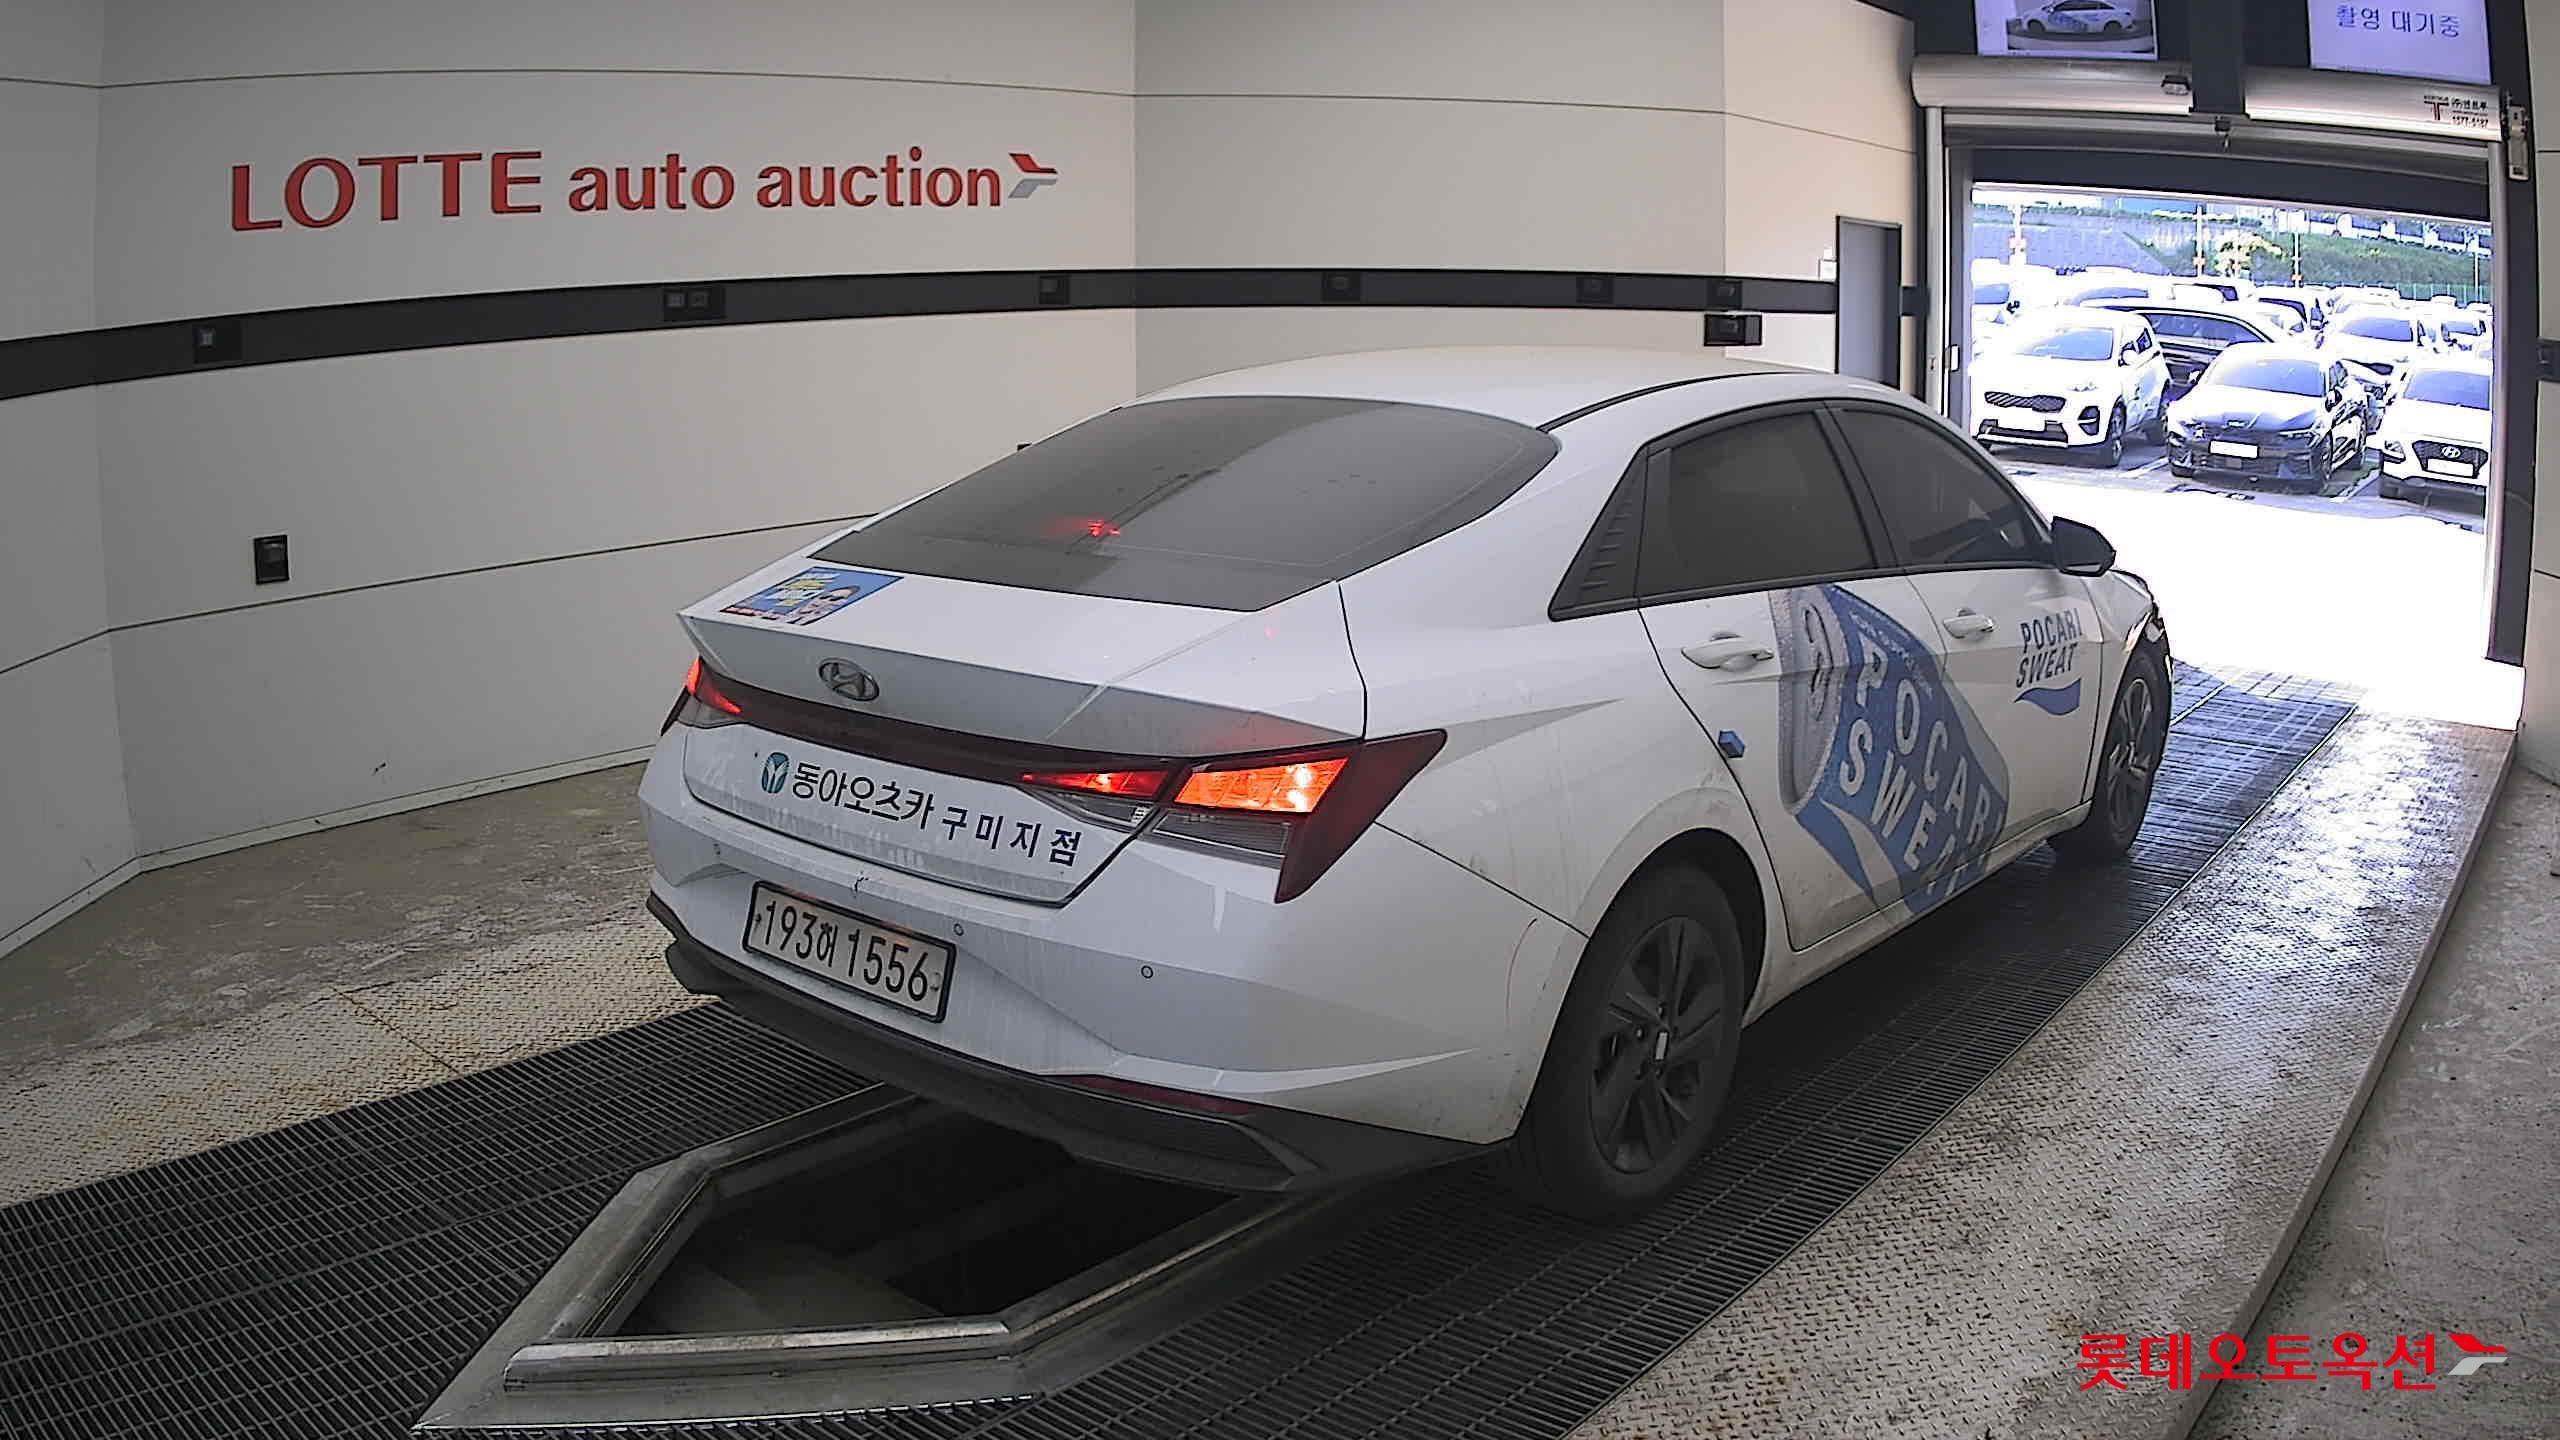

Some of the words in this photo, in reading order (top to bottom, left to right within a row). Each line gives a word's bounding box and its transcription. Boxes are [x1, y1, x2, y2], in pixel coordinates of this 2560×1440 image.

[2337, 4, 2381, 31] 촬영
[2391, 10, 2460, 38] 대기중
[231, 150, 543, 232] LOTTE
[567, 152, 736, 212] auto
[756, 145, 1003, 209] auction
[2020, 607, 2083, 654] POCARI
[2016, 641, 2079, 688] SWEAT
[792, 761, 935, 831] 동아오츠카
